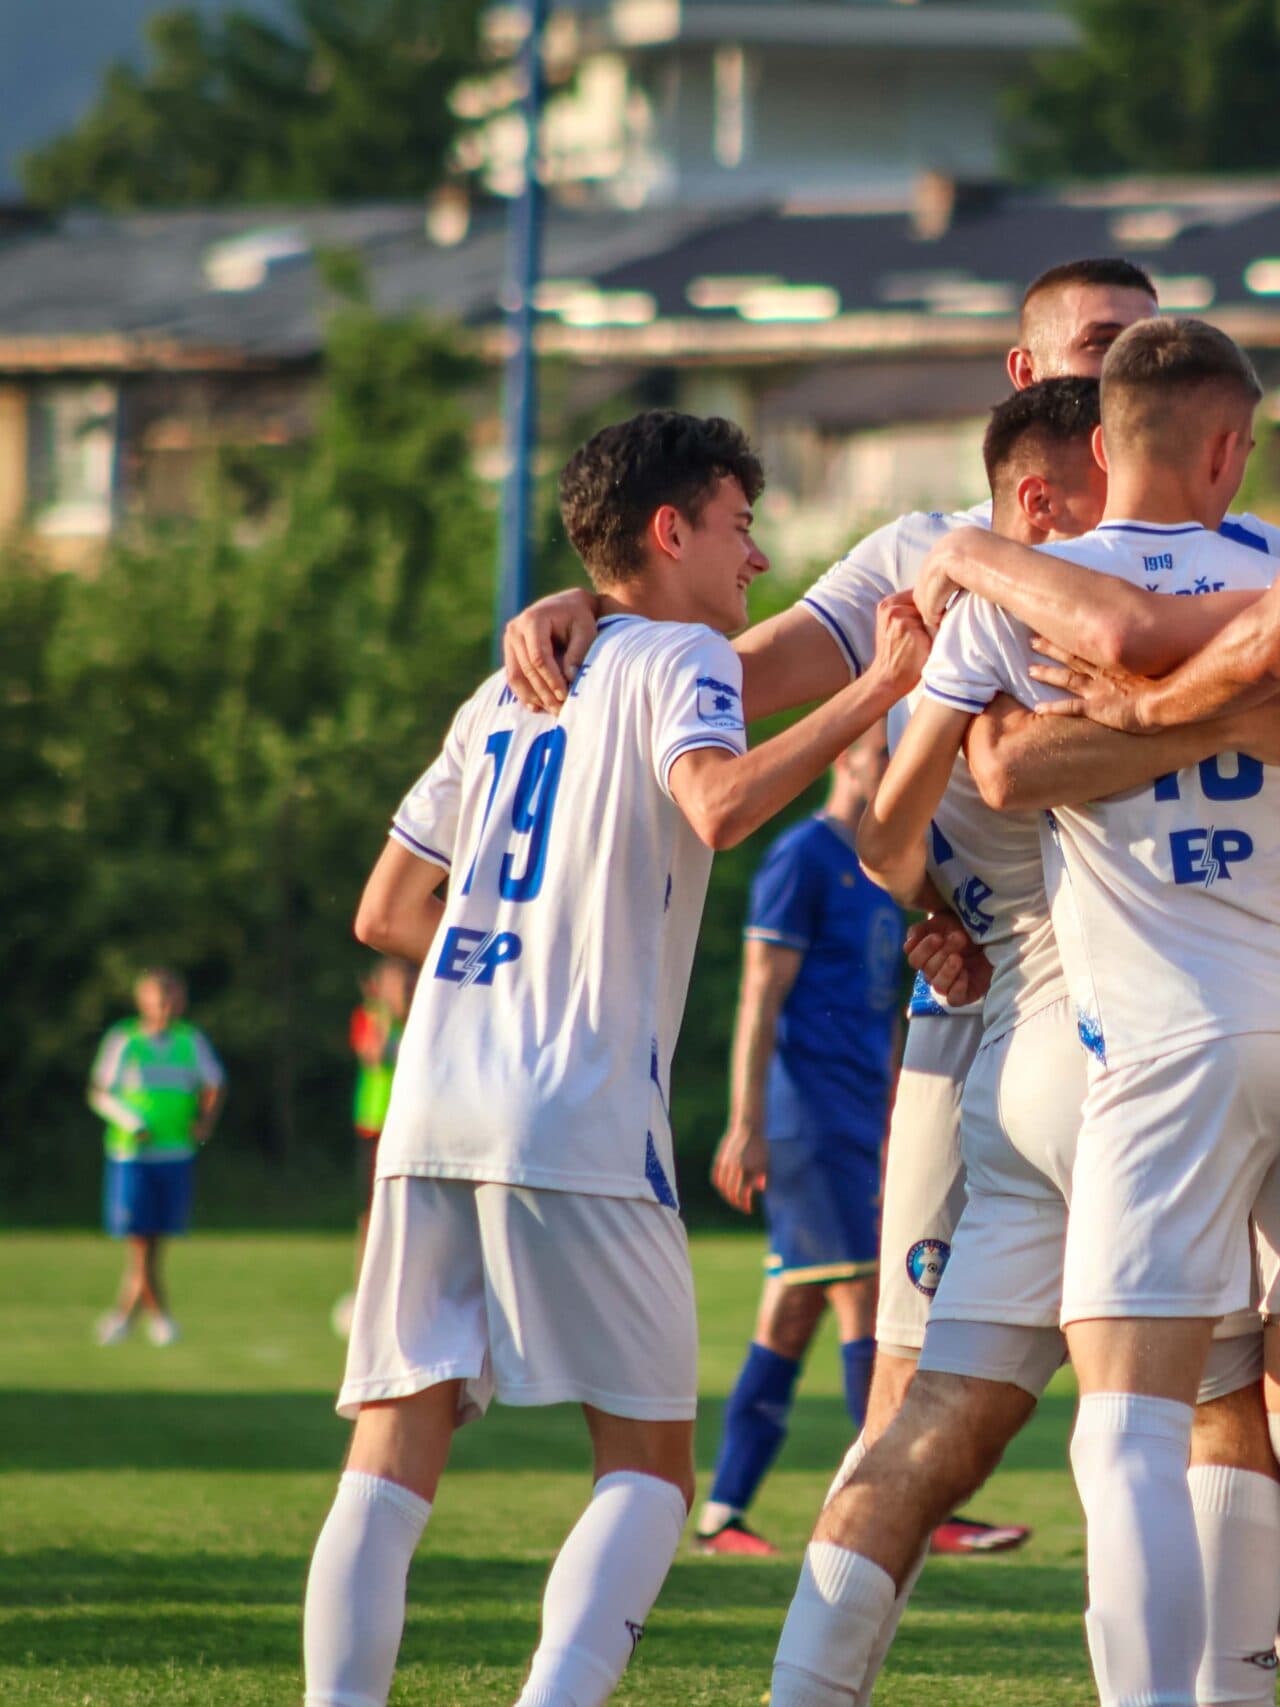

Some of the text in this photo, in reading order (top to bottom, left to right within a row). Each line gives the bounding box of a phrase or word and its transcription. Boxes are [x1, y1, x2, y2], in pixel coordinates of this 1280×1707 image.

[1142, 553, 1173, 572] 1919
[461, 724, 568, 903] 19
[1169, 825, 1254, 888] EP
[433, 926, 523, 989] EP
